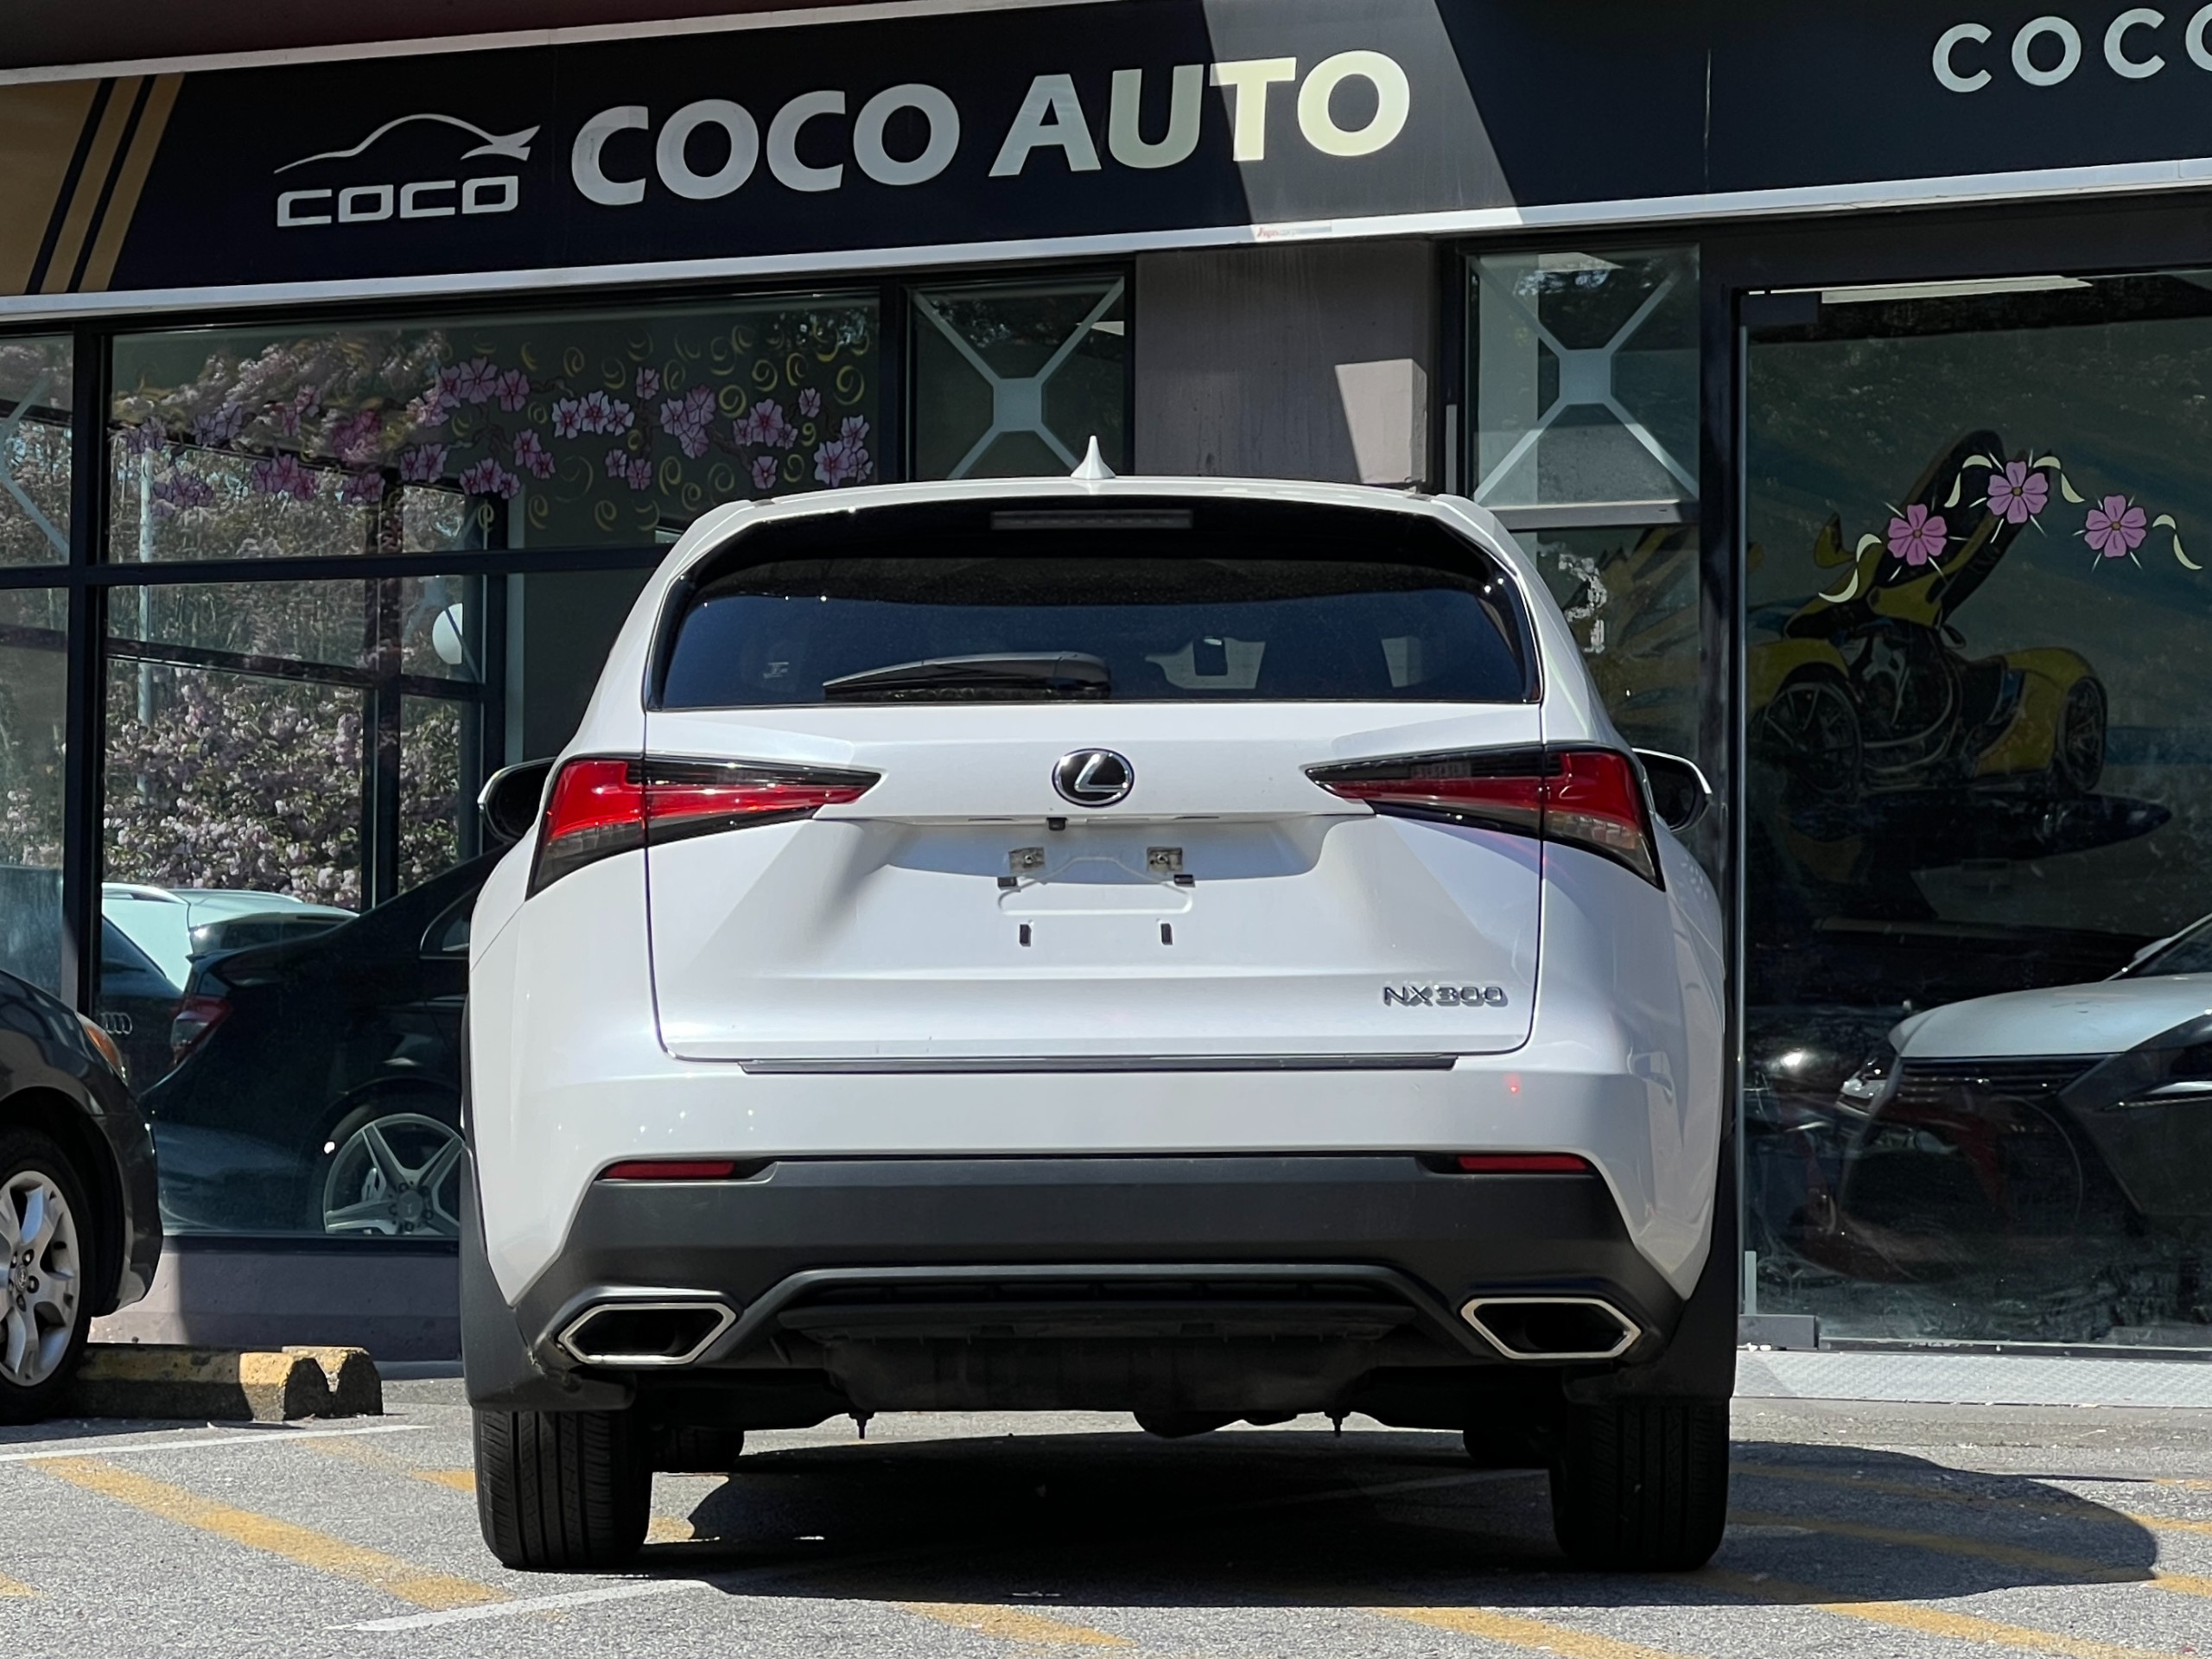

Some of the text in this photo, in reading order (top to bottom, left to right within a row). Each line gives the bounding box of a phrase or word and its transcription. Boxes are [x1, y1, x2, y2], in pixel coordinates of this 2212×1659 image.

[571, 50, 1411, 206] COCO AUTO
[276, 175, 518, 227] COCO
